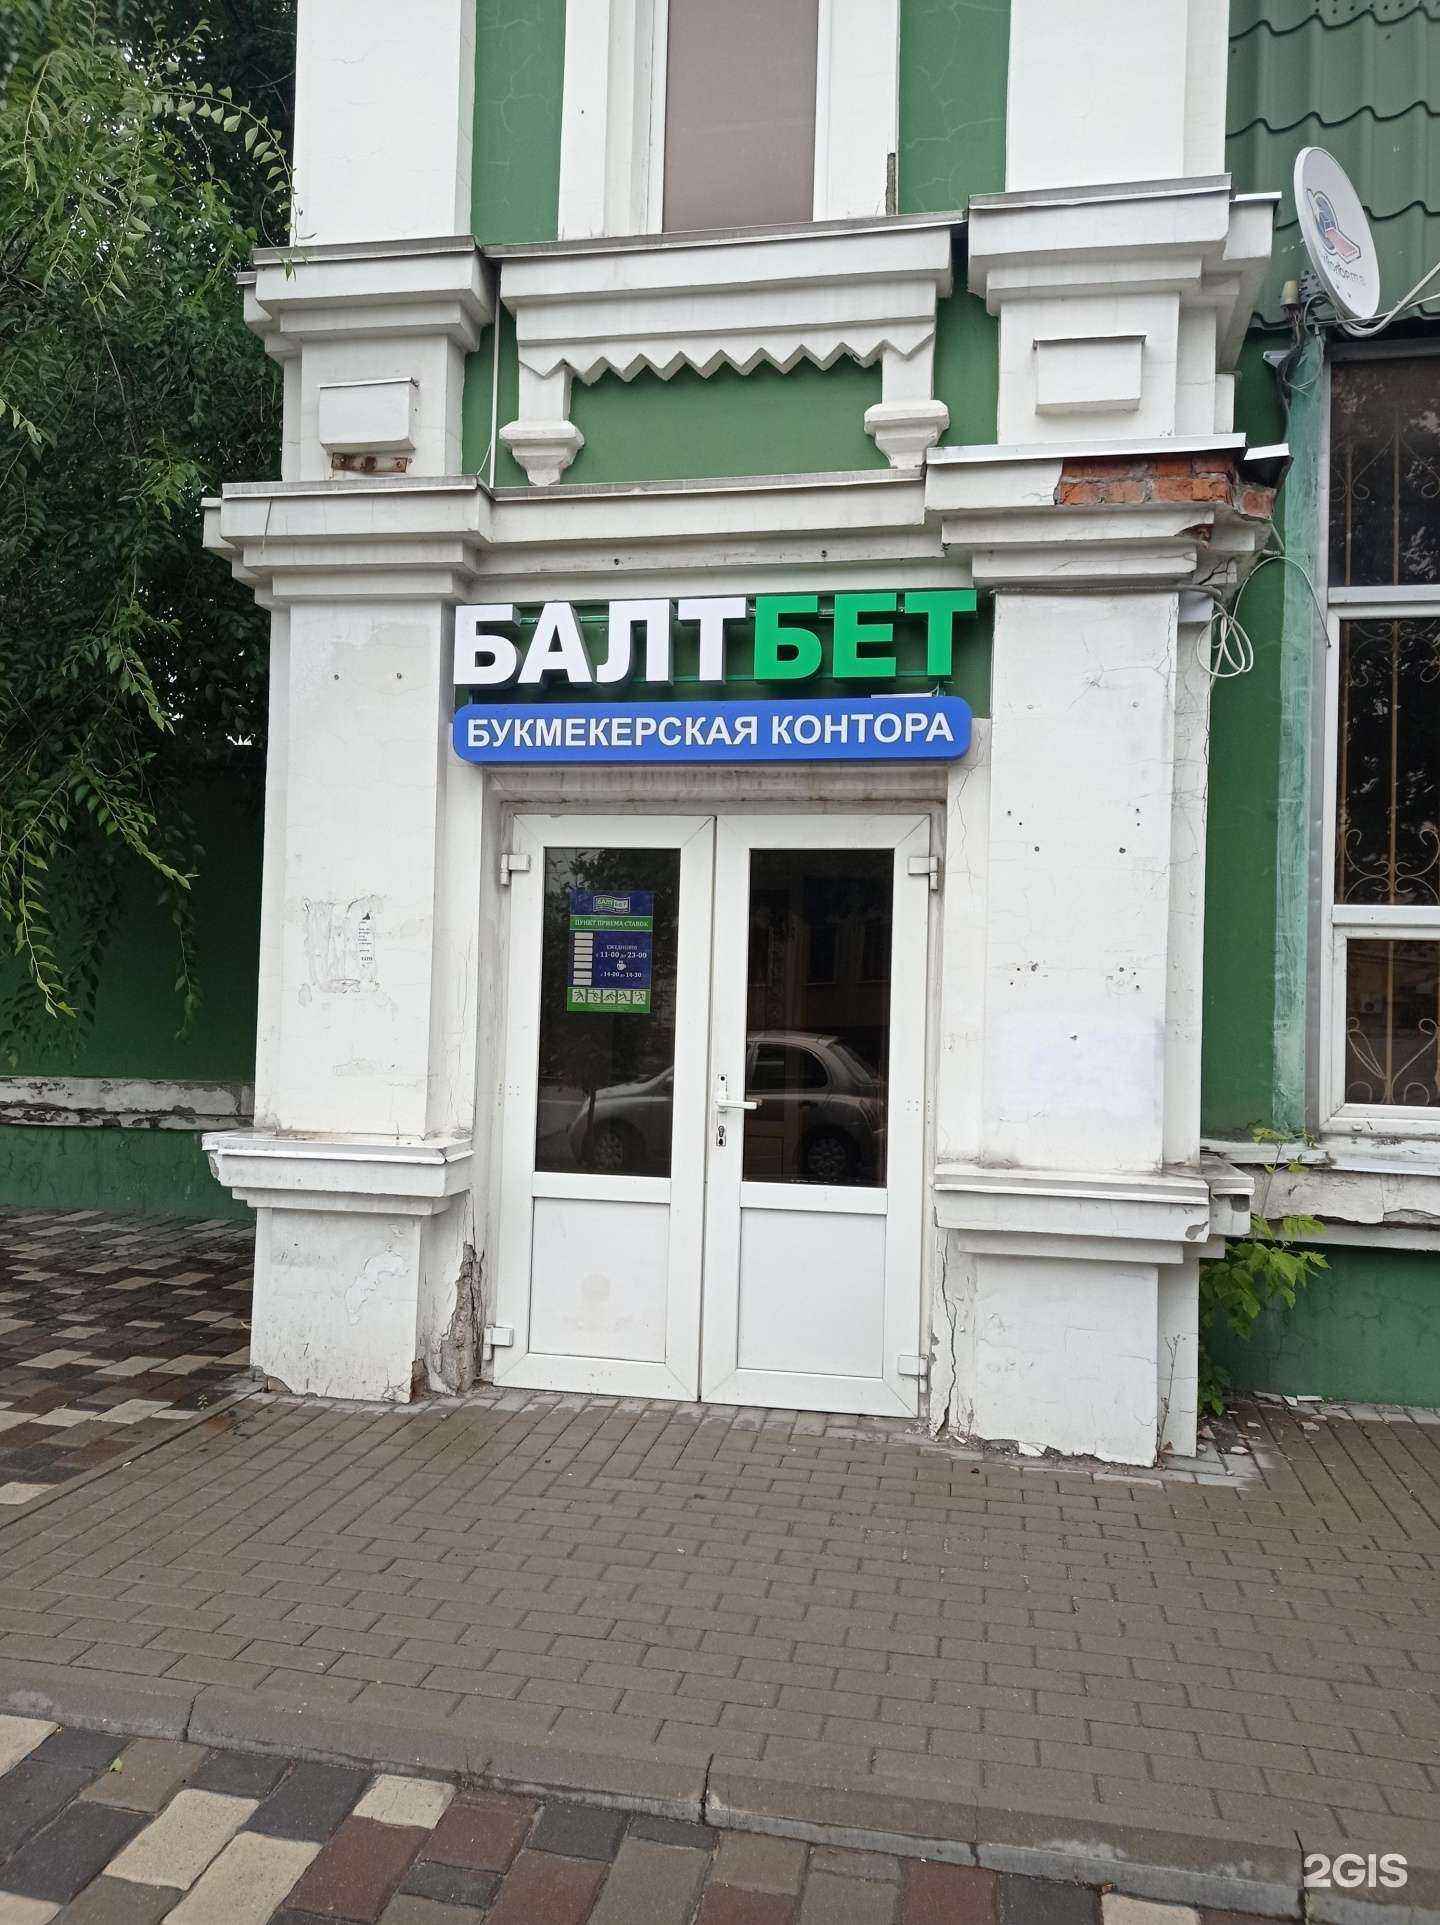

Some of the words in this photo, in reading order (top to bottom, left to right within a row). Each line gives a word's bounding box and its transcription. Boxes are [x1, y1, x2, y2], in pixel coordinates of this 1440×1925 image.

[454, 590, 976, 684] БАЛТБЕТ
[467, 717, 757, 748] БУКМЕКЕРСКАЯ
[771, 712, 955, 744] КОНТОРА
